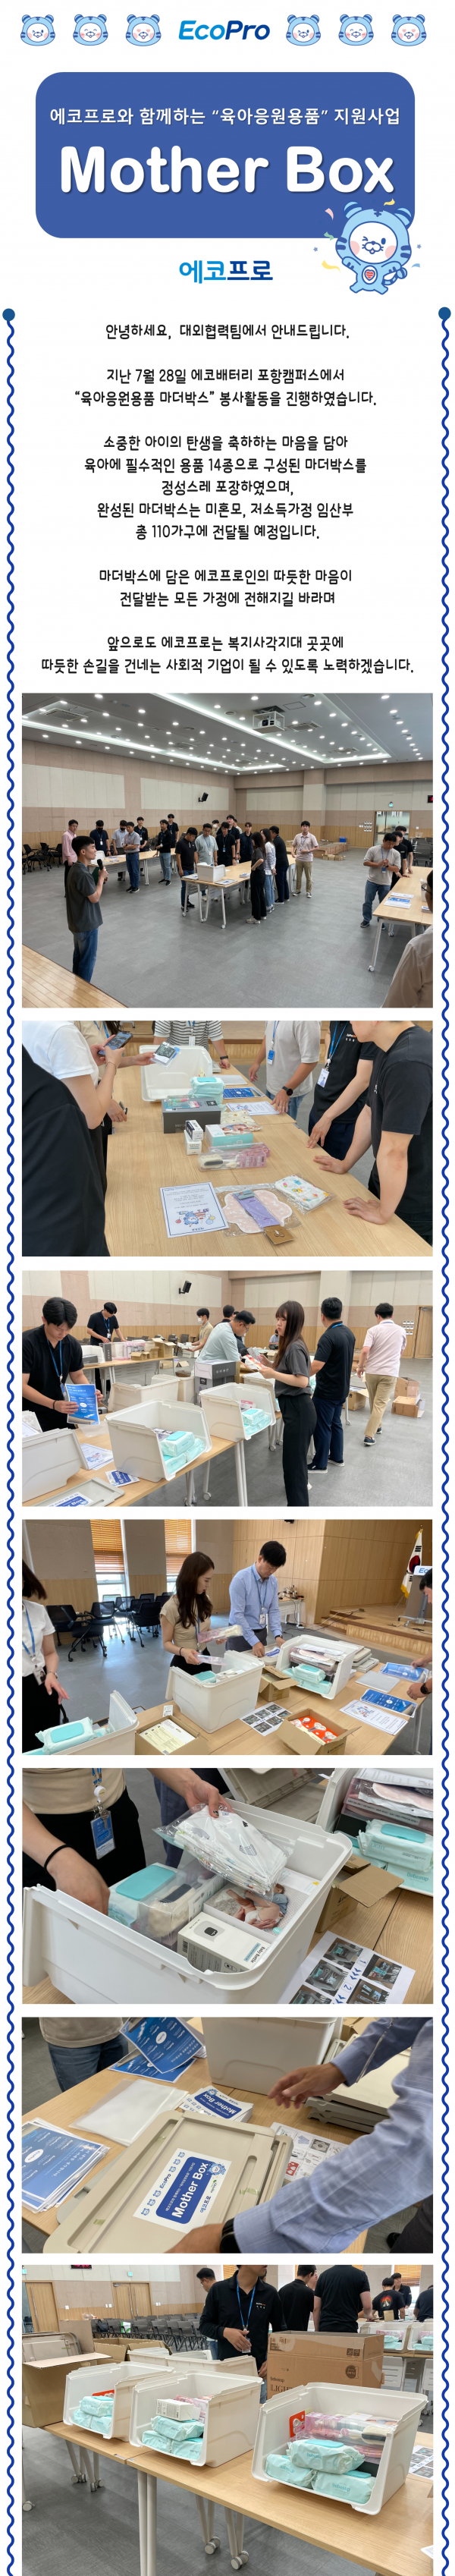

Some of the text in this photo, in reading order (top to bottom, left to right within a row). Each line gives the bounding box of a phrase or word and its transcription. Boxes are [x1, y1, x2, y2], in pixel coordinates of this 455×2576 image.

[202, 2093, 215, 2103] Box
[214, 2101, 237, 2115] Mother
[159, 2173, 171, 2189] EcoPro
[171, 2162, 209, 2218] Mother Box
[270, 2384, 293, 2392] LIGH
